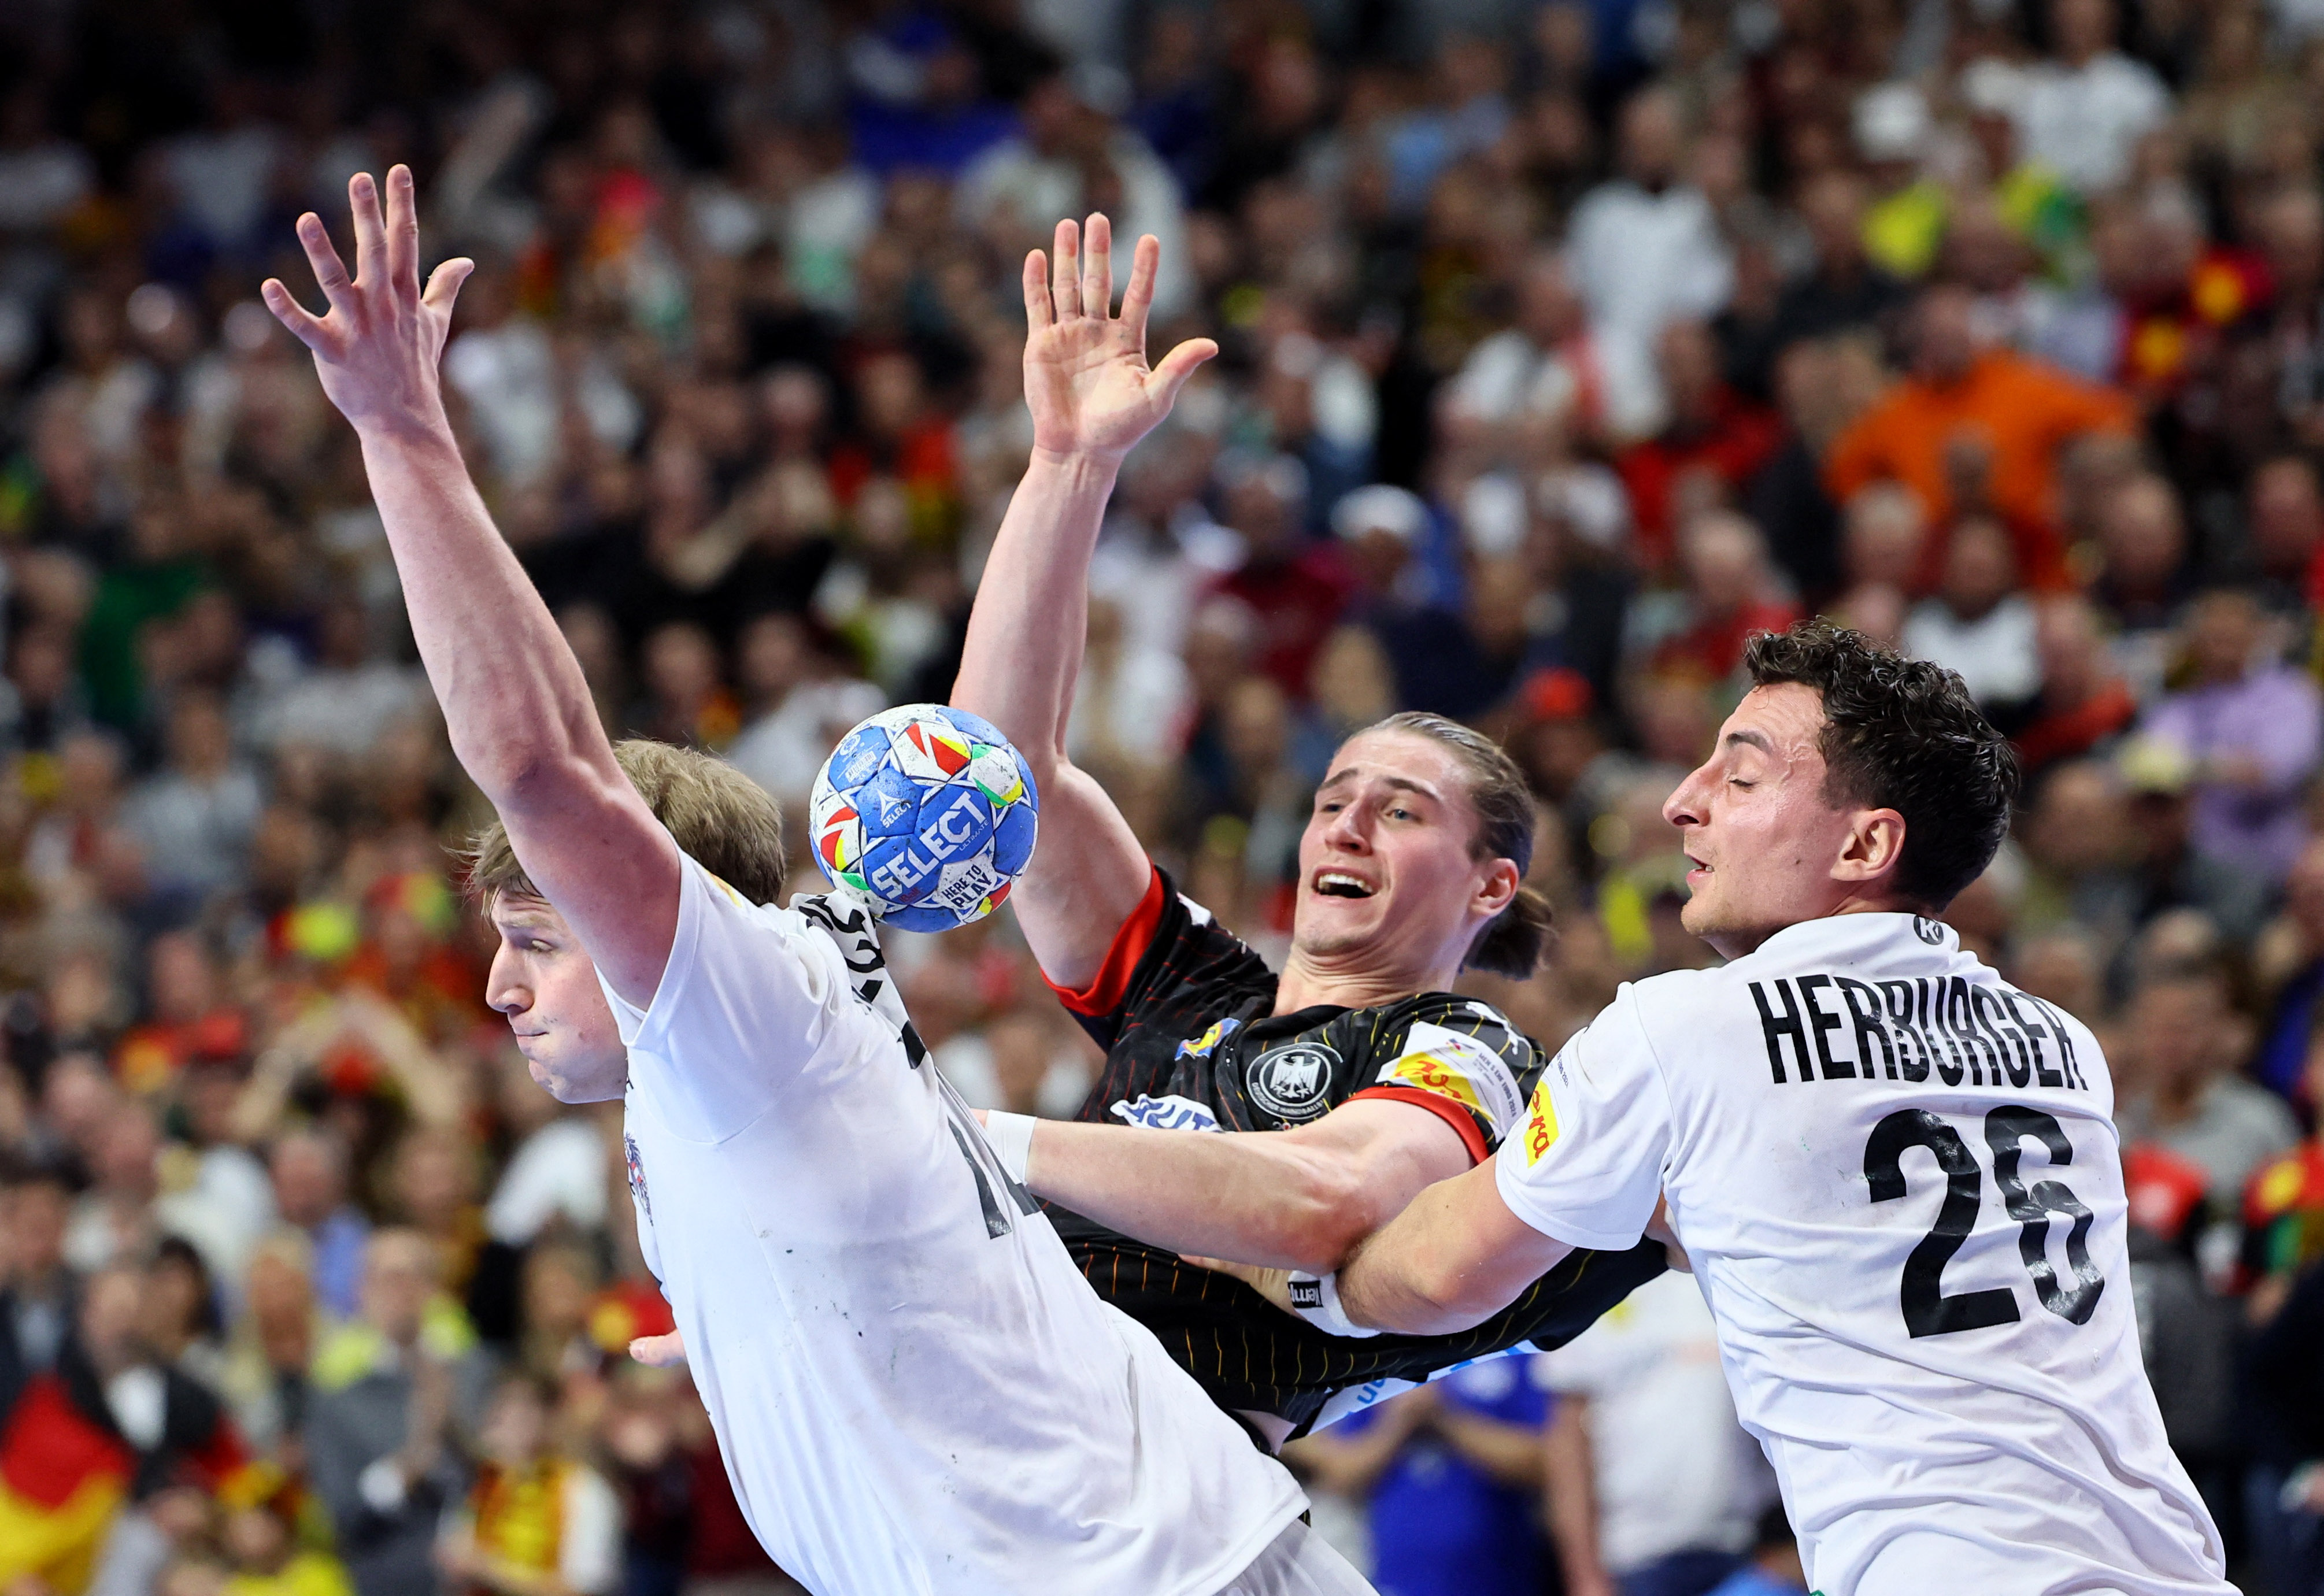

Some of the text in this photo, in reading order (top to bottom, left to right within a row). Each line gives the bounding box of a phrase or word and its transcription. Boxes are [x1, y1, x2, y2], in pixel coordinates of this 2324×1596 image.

[882, 802, 912, 828] SELECT
[872, 791, 986, 899] SELECT
[959, 819, 990, 851] ULTIMATE
[941, 864, 982, 900] HERE TO
[951, 872, 992, 908] PLAY
[1748, 973, 2089, 1091] HERBURGER
[1863, 1104, 2105, 1339] 26
